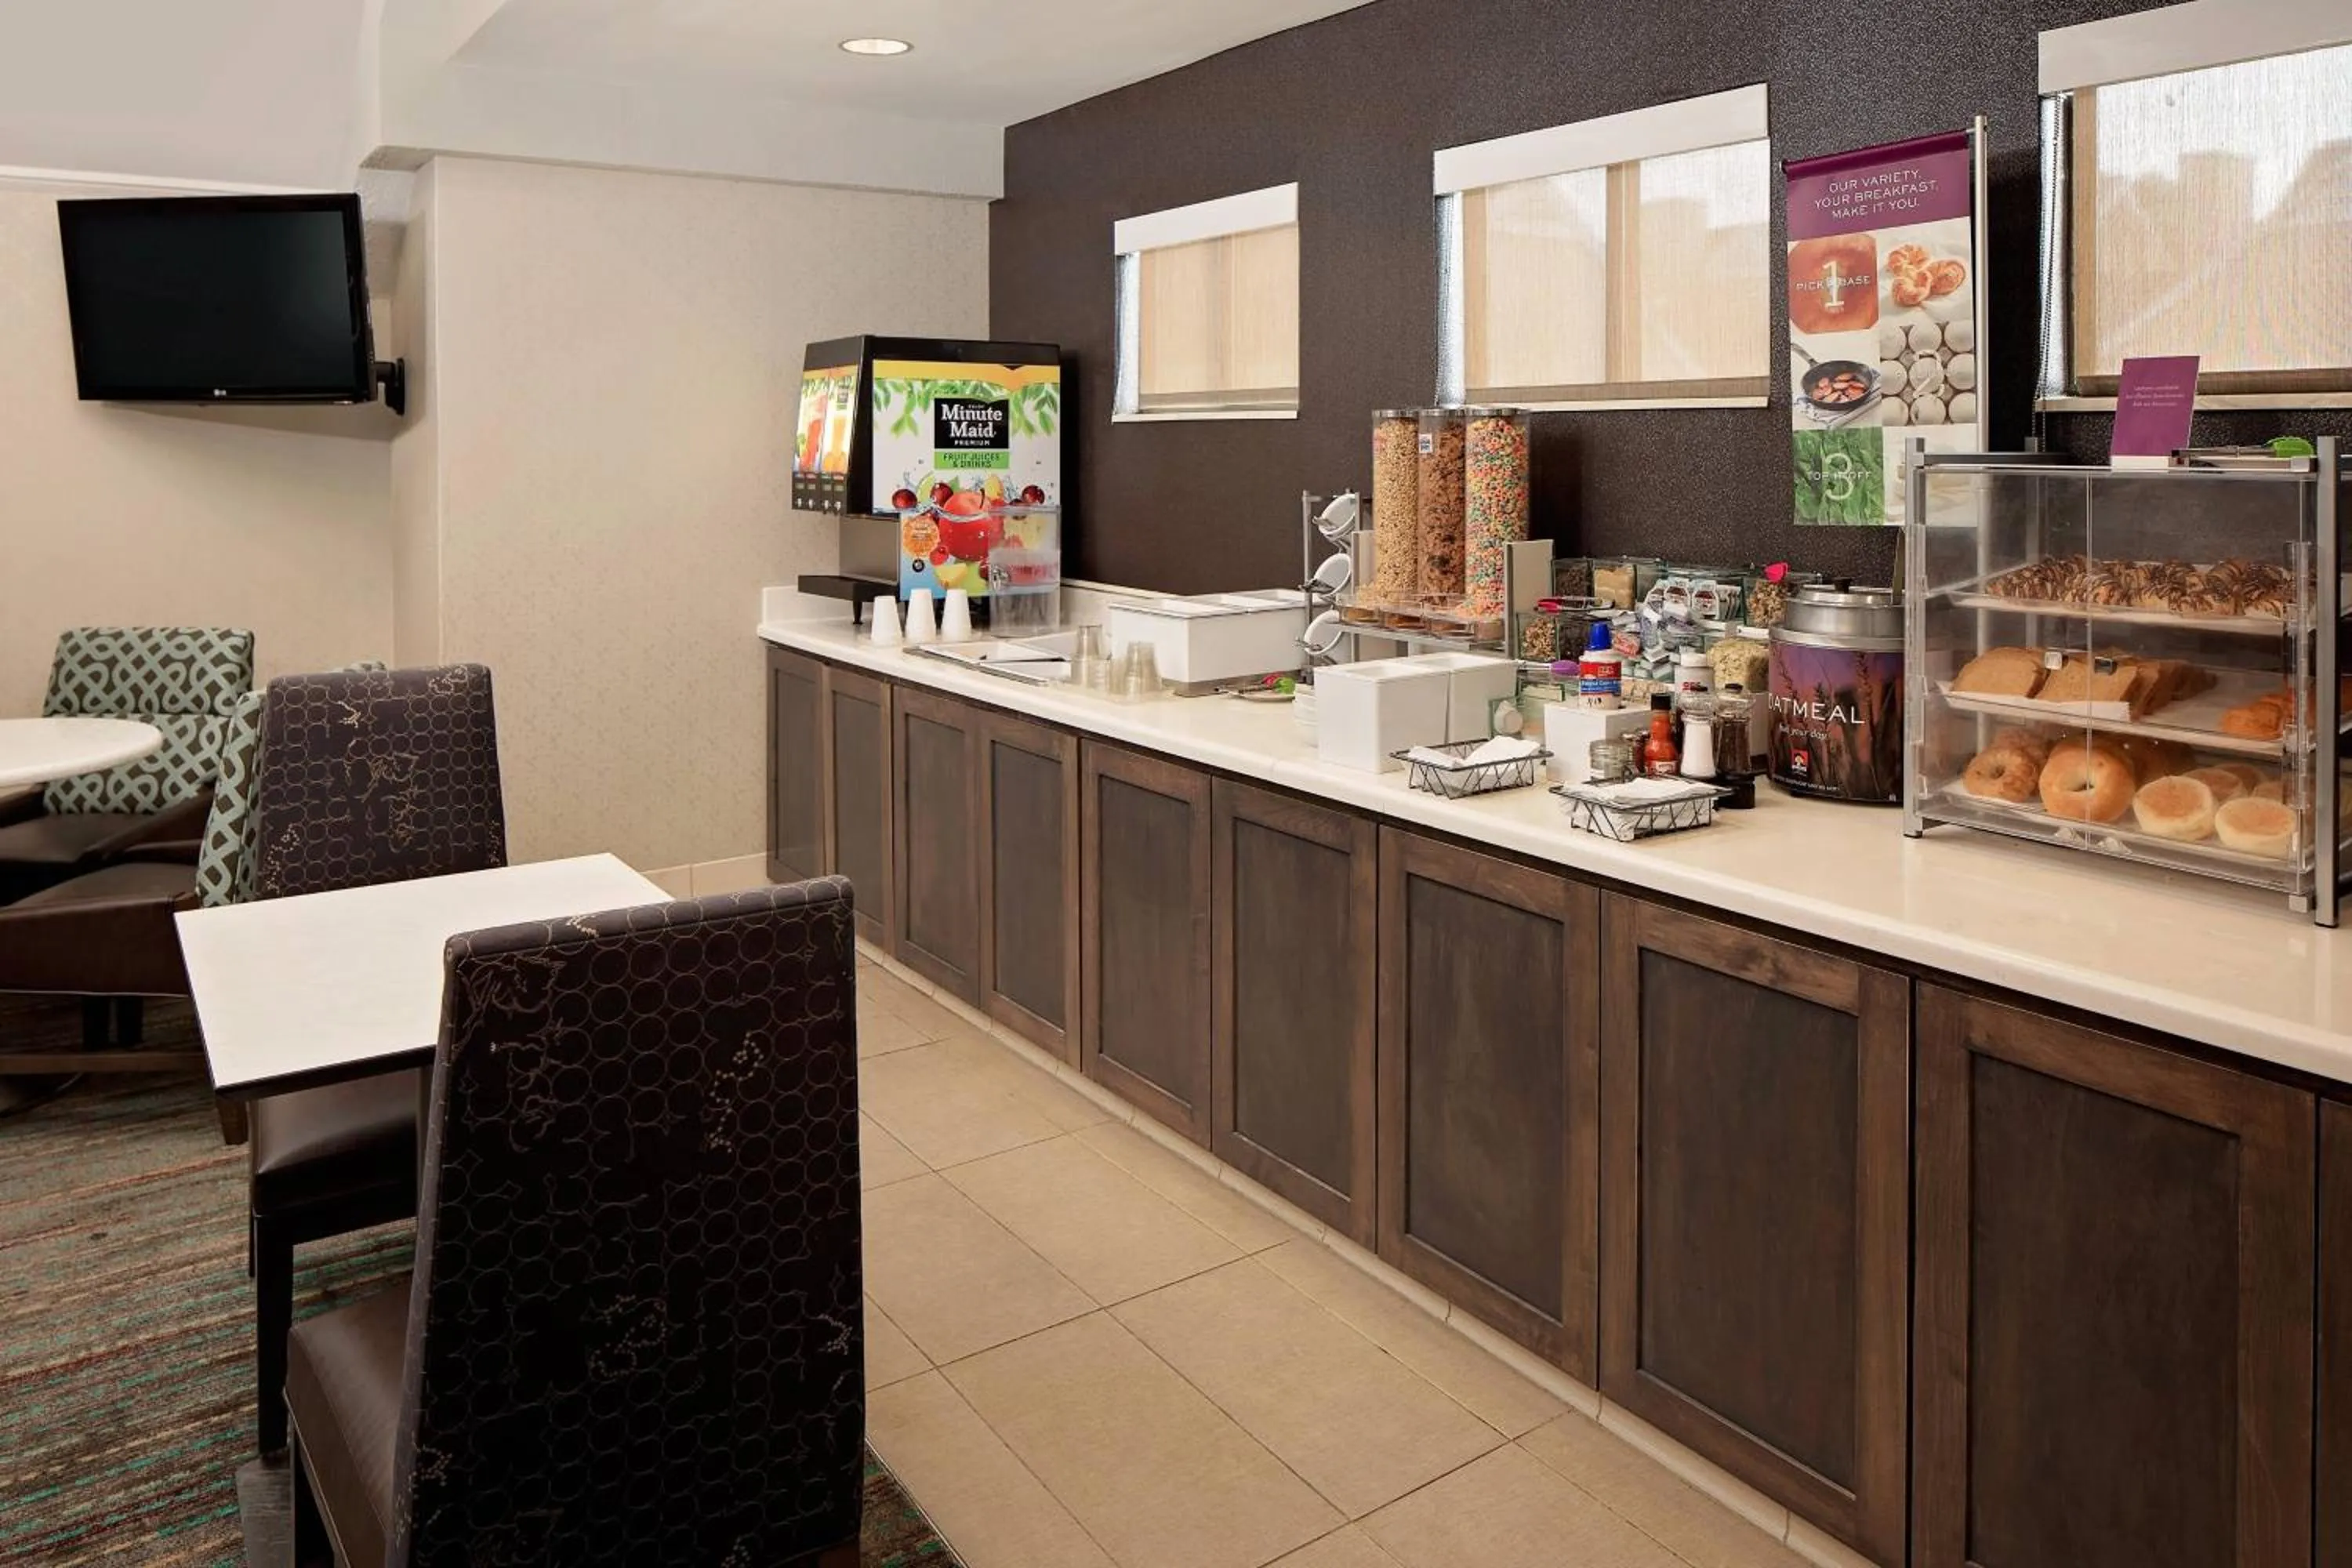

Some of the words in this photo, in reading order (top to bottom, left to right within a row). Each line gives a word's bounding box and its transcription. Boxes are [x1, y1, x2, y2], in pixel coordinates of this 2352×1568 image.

[1829, 180, 1857, 193] OUR
[1862, 169, 1922, 187] VARIETY.
[1815, 194, 1851, 209] YOUR
[1832, 205, 1868, 219] MAKE
[1873, 202, 1883, 213] IT
[1889, 198, 1920, 210] YOU.
[1796, 281, 1824, 291] PICK
[1822, 260, 1845, 307] 1
[1913, 350, 1944, 398] 2
[941, 404, 1003, 421] Minute
[949, 421, 994, 438] Maid
[971, 452, 1000, 461] JUICES
[1825, 452, 1853, 500] 3
[1769, 693, 1865, 724] OATMEAL
